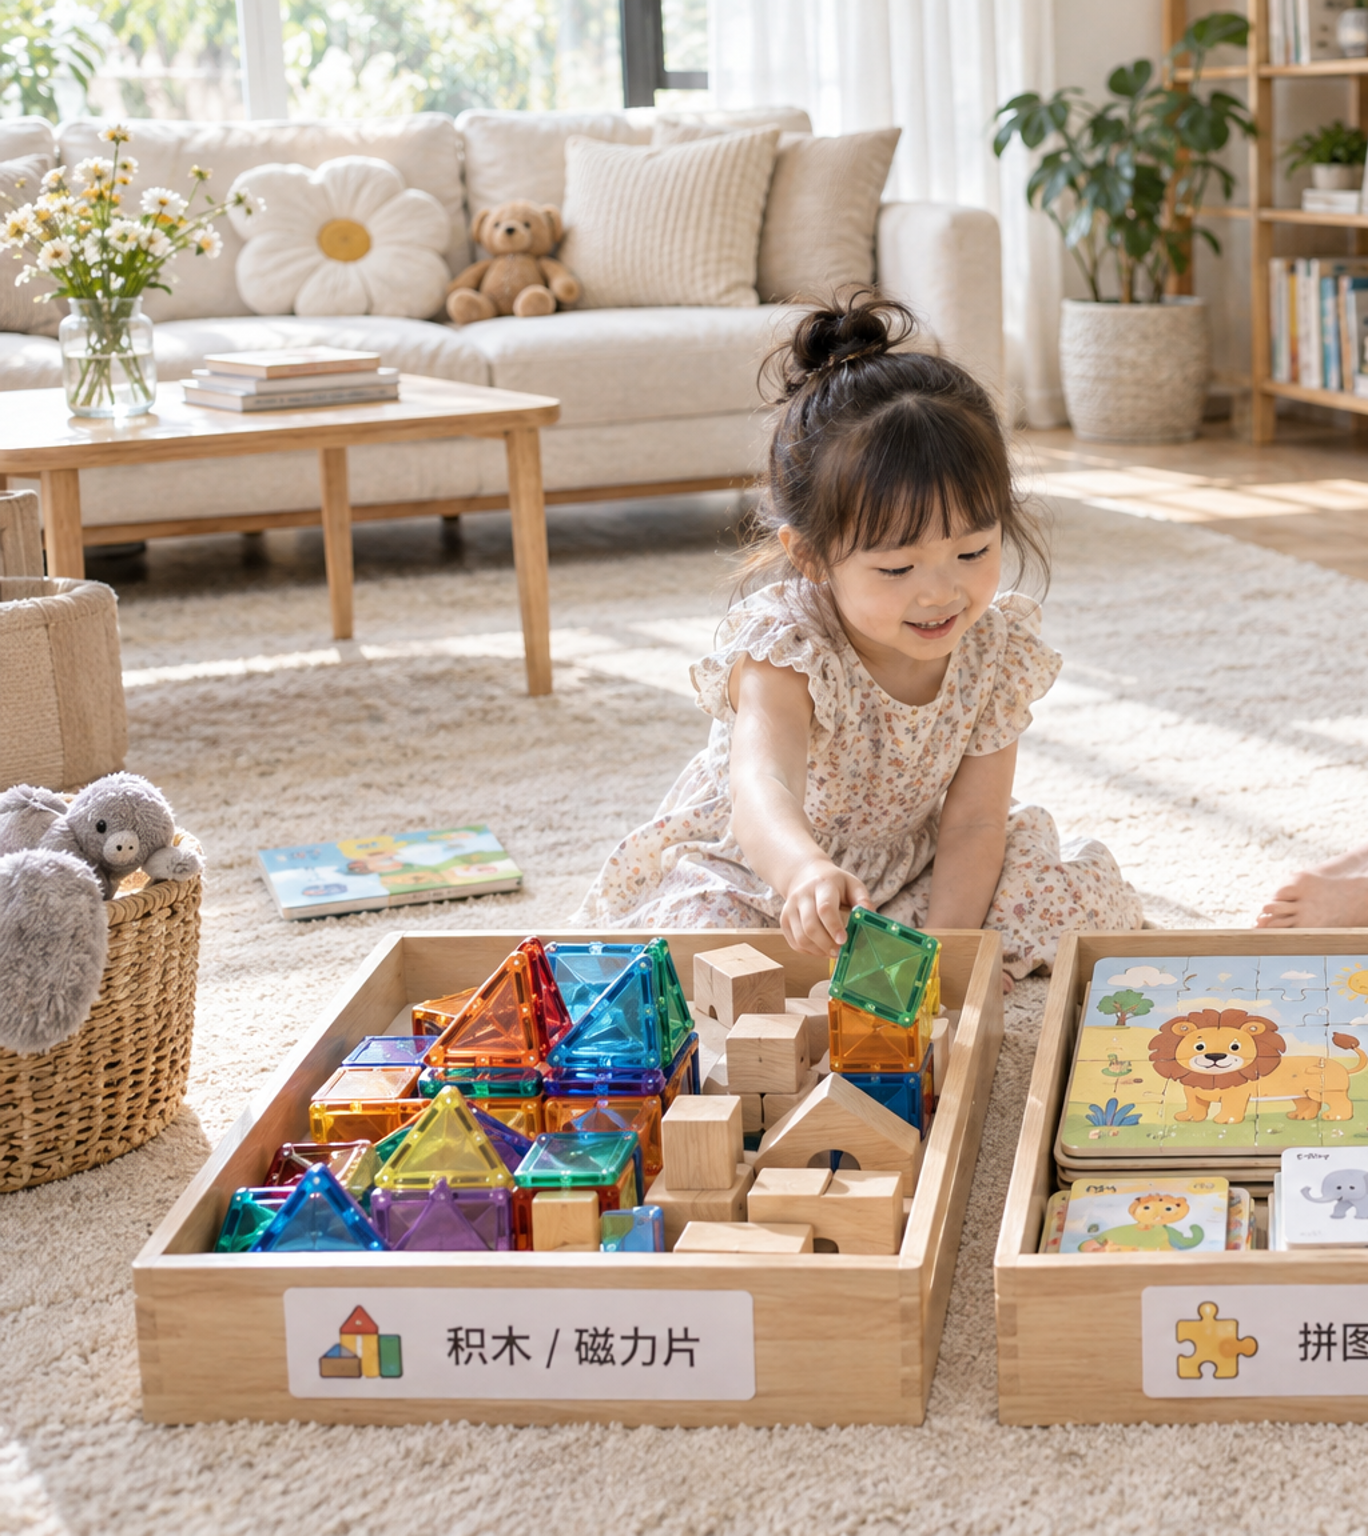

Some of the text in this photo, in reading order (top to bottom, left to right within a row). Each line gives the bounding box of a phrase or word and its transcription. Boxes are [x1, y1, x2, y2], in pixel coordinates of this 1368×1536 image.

[446, 1325, 701, 1369] 积木 / 磁力片
